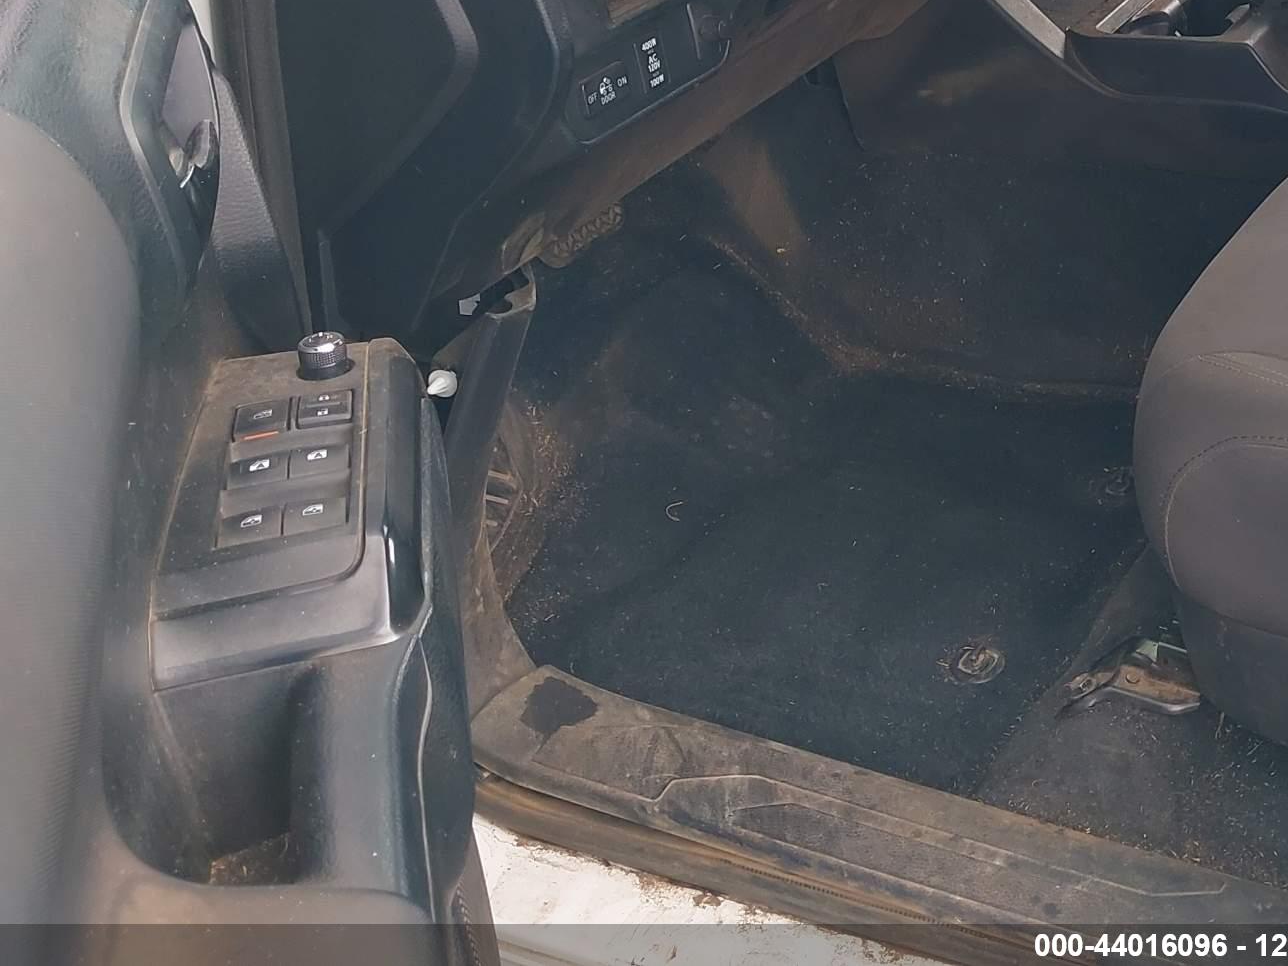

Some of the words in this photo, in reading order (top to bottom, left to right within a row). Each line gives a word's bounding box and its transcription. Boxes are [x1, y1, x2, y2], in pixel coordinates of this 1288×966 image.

[648, 53, 658, 64] AC
[648, 60, 660, 72] 120V
[617, 76, 628, 86] ON
[588, 92, 598, 104] OFF
